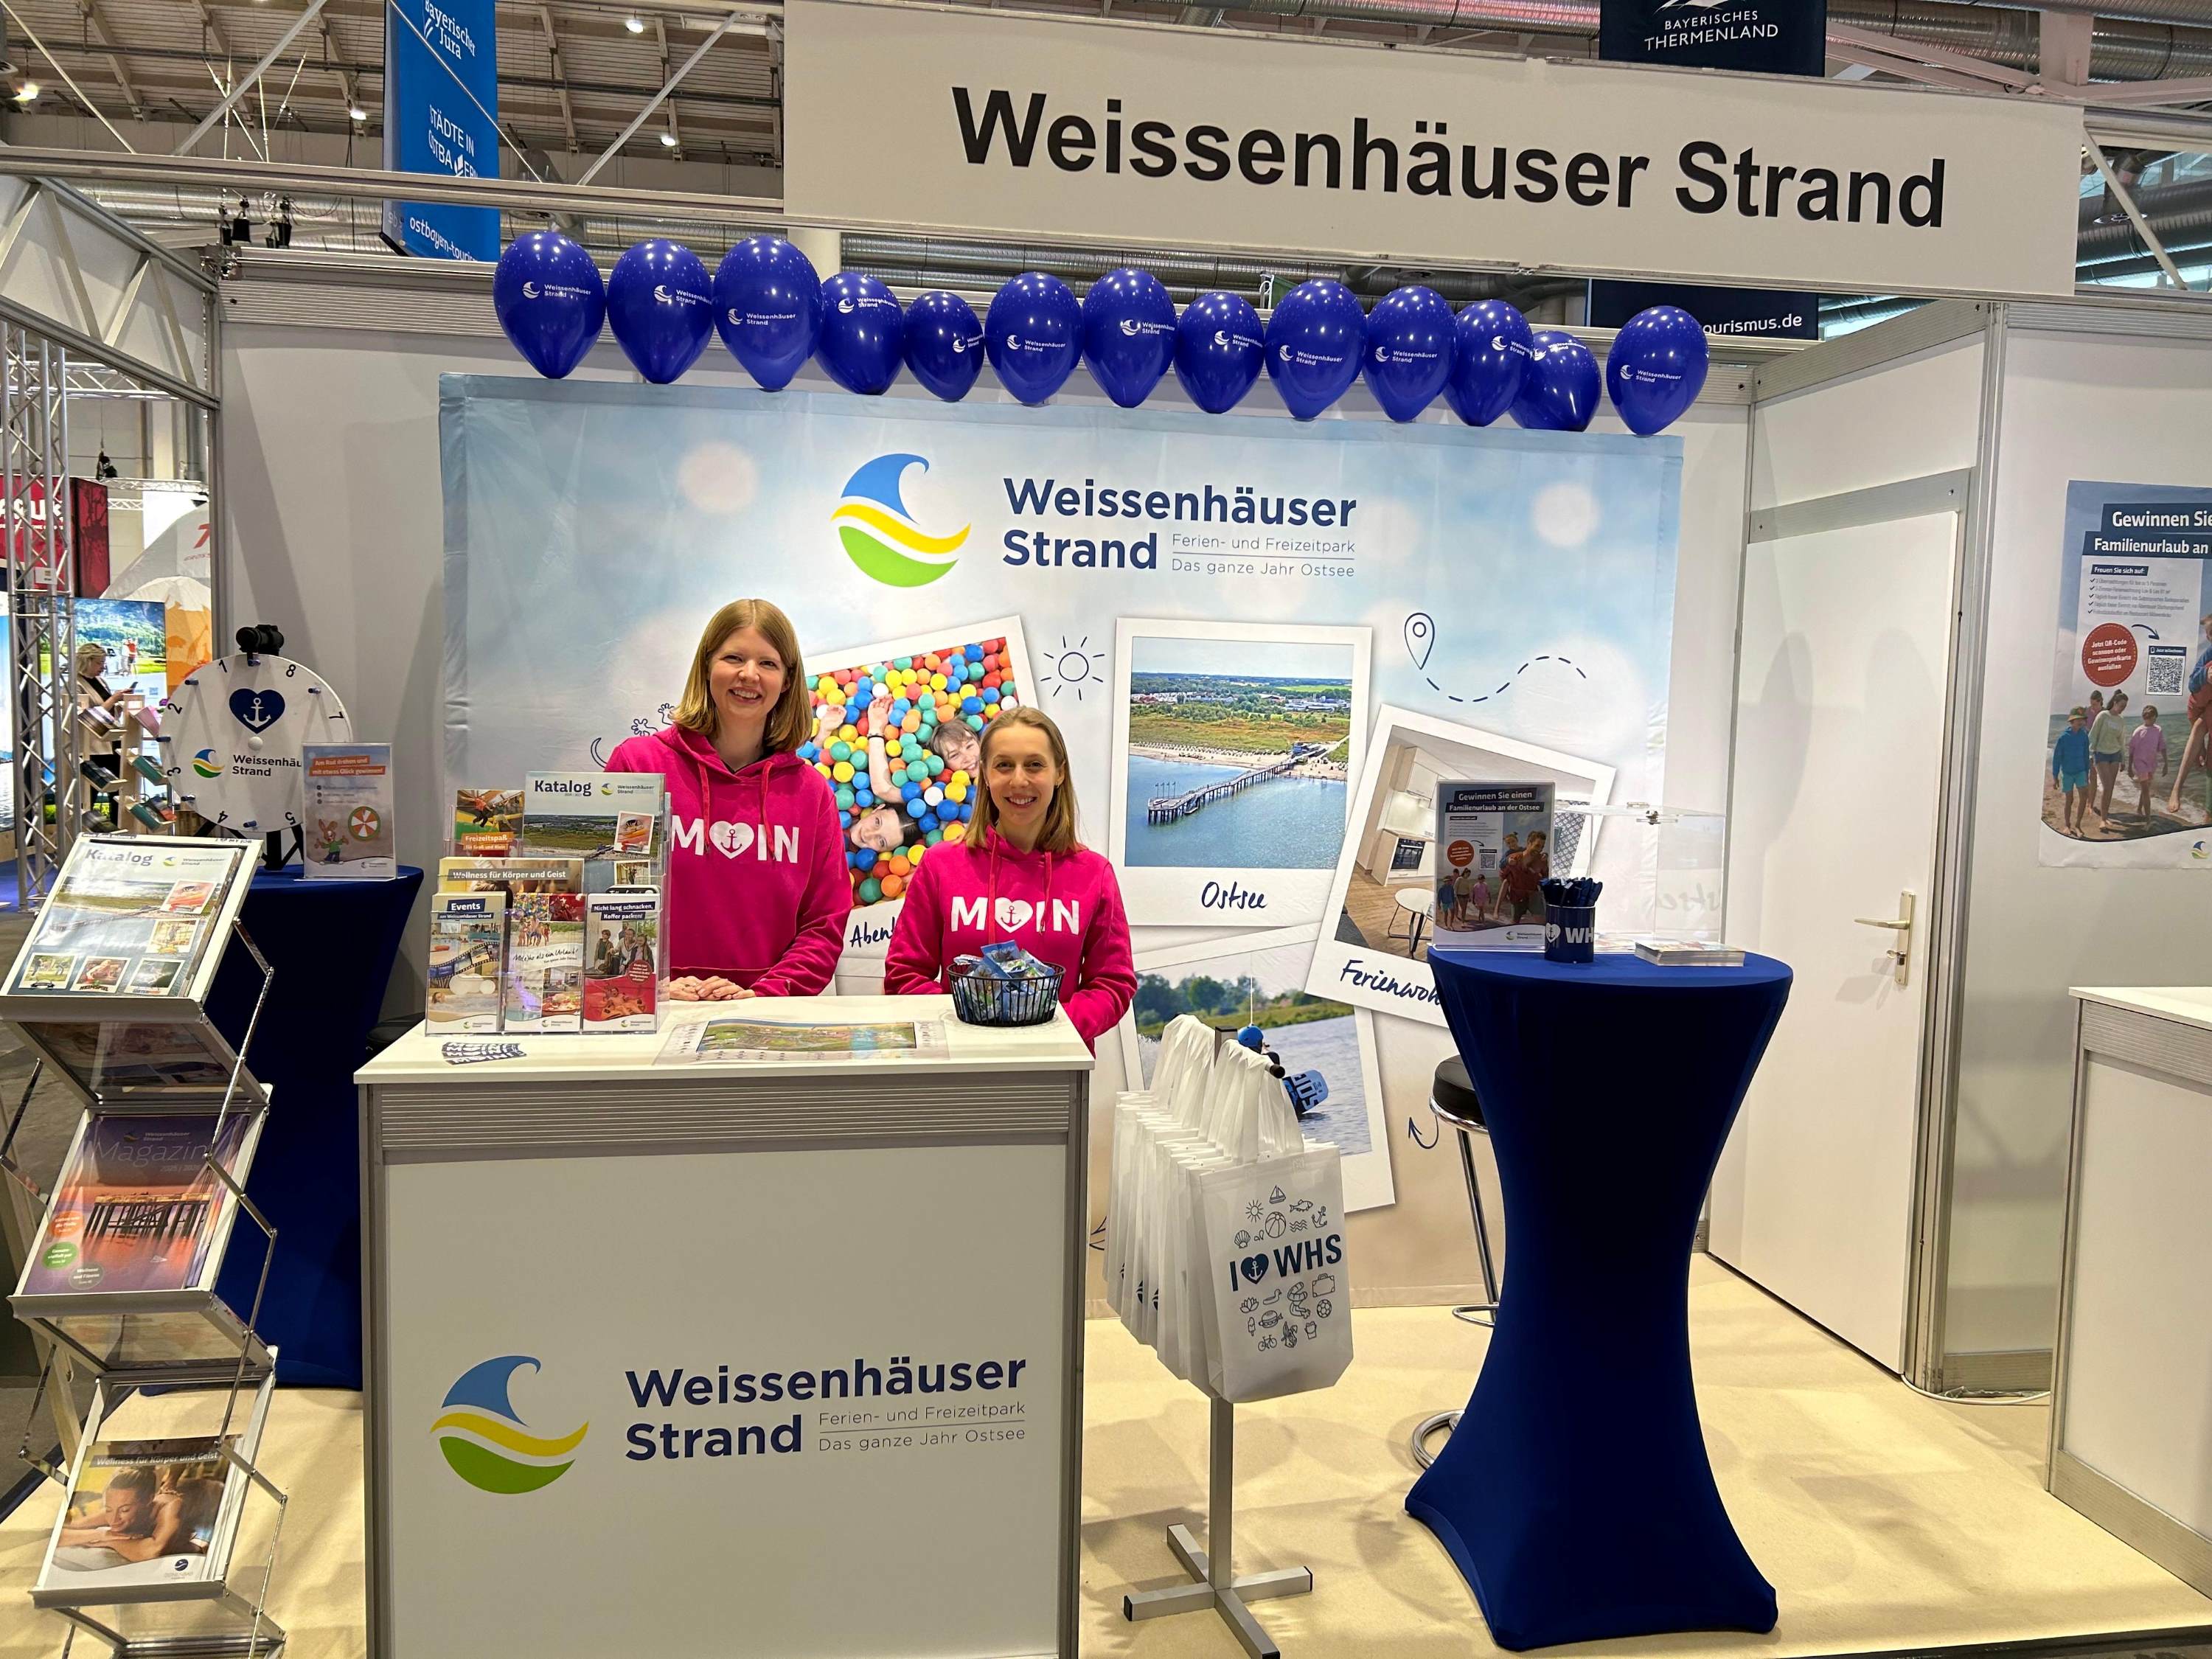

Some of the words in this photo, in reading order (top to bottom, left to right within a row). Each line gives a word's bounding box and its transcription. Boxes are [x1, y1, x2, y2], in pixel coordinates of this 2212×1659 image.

[1665, 10, 1758, 30] BAYERISCHES
[439, 27, 462, 60] Jura
[1644, 24, 1778, 51] THERMENLAND
[466, 133, 475, 157] IN
[953, 87, 1649, 208] Weissenhäuser
[1676, 141, 1946, 228] Strand
[675, 296, 696, 305] Strand
[1703, 313, 1802, 334] ourismus.de
[1295, 357, 1317, 366] Strand
[1392, 355, 1413, 364] Strand
[1635, 375, 1656, 383] Strand
[1003, 478, 1357, 526] Weissenhäuser
[2112, 510, 2189, 526] Gewinnen
[1003, 530, 1158, 569] Strand
[1172, 533, 1226, 547] Ferien-
[1231, 535, 1259, 550] und
[1266, 537, 1355, 554] Freizeitpark
[2094, 538, 2189, 554] Familienurlaub
[2192, 544, 2208, 554] an
[1172, 559, 1203, 573] Das
[1207, 563, 1254, 577] ganze
[1260, 561, 1294, 575] Jahr
[1300, 565, 1355, 577] Ostsee
[218, 659, 228, 673] 1
[286, 664, 296, 678] 8
[167, 703, 183, 714] 2
[329, 712, 344, 721] 7
[233, 754, 302, 768] Weissenhäu
[167, 767, 181, 776] 3
[232, 765, 271, 776] Strand
[535, 780, 592, 797] Katalog
[1458, 792, 1496, 801] Gewinnen
[1498, 791, 1509, 799] Sie
[1512, 791, 1532, 799] einen
[217, 811, 229, 824] 4
[285, 812, 296, 825] 5
[465, 834, 508, 842] Freizeitspaß
[503, 871, 529, 880] Körper
[547, 870, 566, 878] Geist
[1201, 880, 1268, 910] Ostsee
[451, 902, 481, 911] Events
[95, 1141, 206, 1167] Magazin
[1230, 1260, 1239, 1291] I
[1273, 1233, 1343, 1277] WHS
[625, 1356, 1026, 1408] Weissenhäuser
[625, 1415, 802, 1461] Strand
[818, 1410, 880, 1426] Ferien-
[886, 1408, 919, 1423] und
[925, 1401, 1026, 1421] Freizeitpark
[818, 1436, 852, 1452] Das
[859, 1434, 913, 1452] ganze
[919, 1430, 959, 1447] Jahr
[965, 1426, 1026, 1443] Ostsee
[97, 1457, 134, 1466] Wellness
[136, 1456, 147, 1464] für
[150, 1455, 178, 1464] Körper
[198, 1452, 218, 1460] Geist
